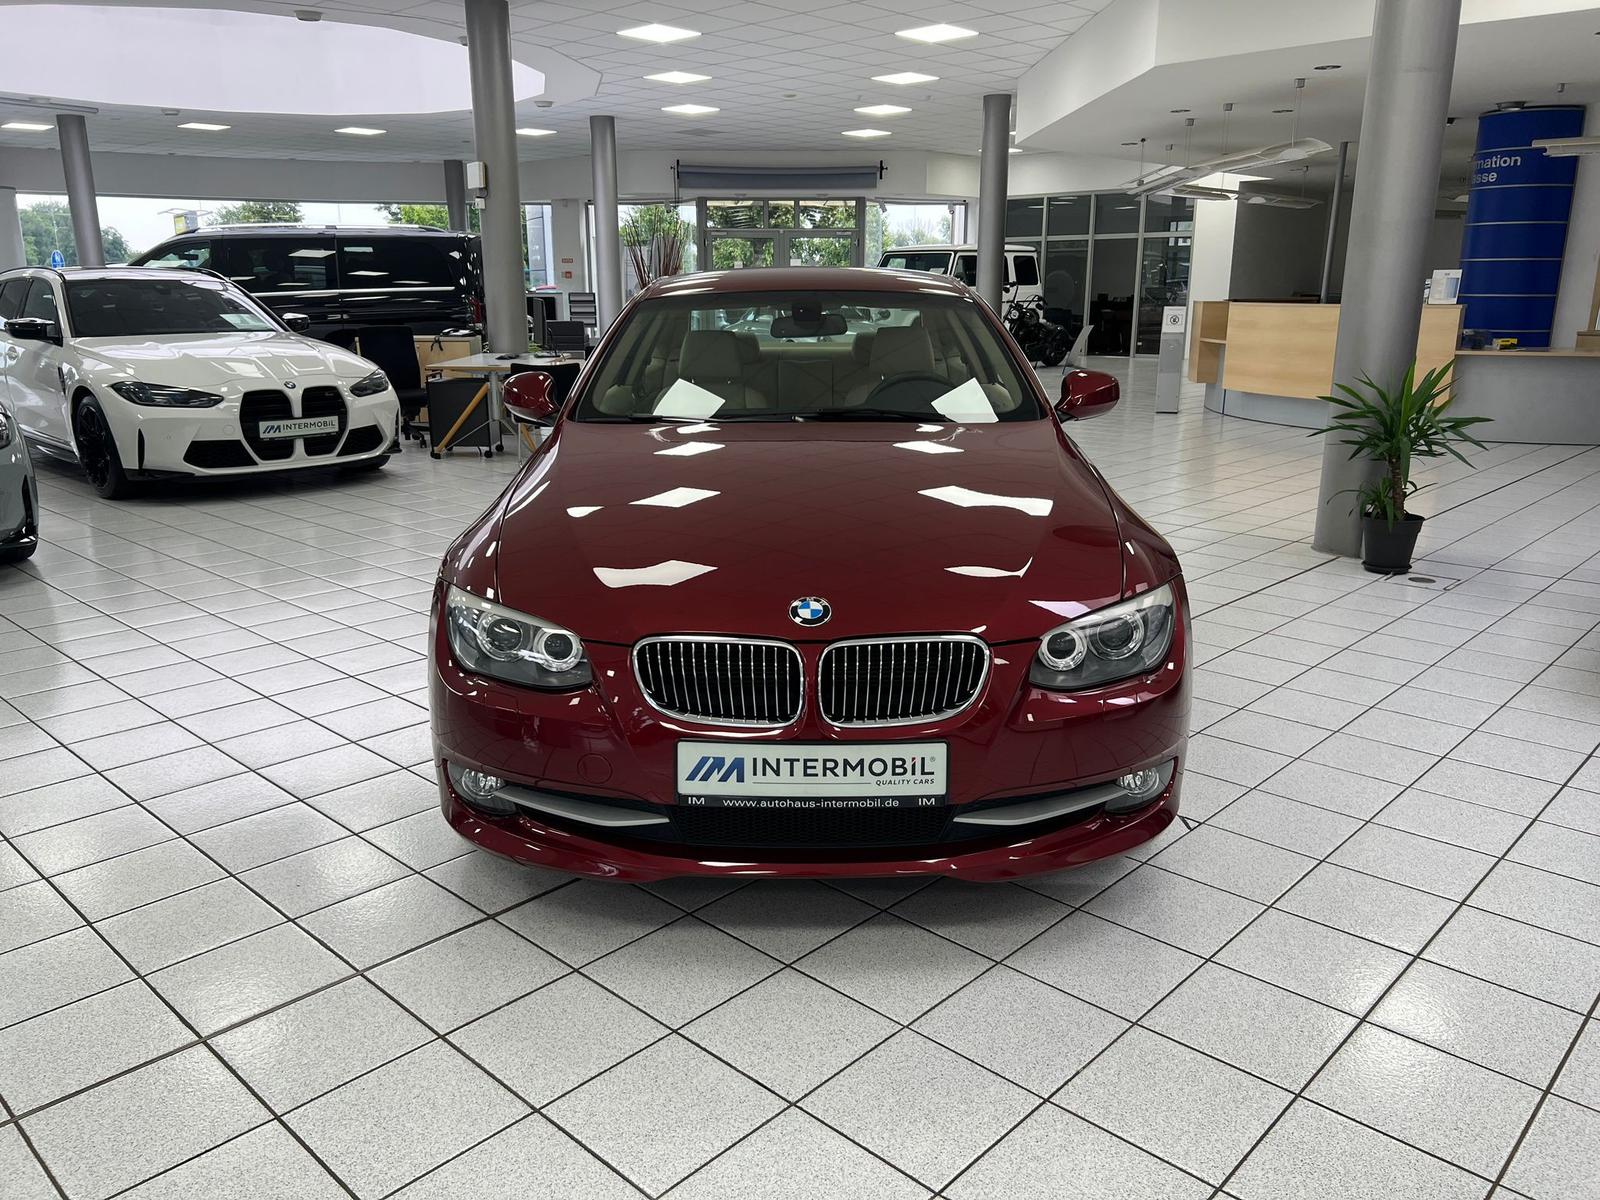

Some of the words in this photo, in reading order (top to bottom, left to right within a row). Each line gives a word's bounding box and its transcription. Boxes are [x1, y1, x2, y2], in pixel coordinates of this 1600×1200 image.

[875, 778, 911, 787] QUALITY
[688, 796, 705, 805] IM
[722, 798, 900, 809] www.autohaus-intermobil.de
[918, 797, 936, 806] IM
